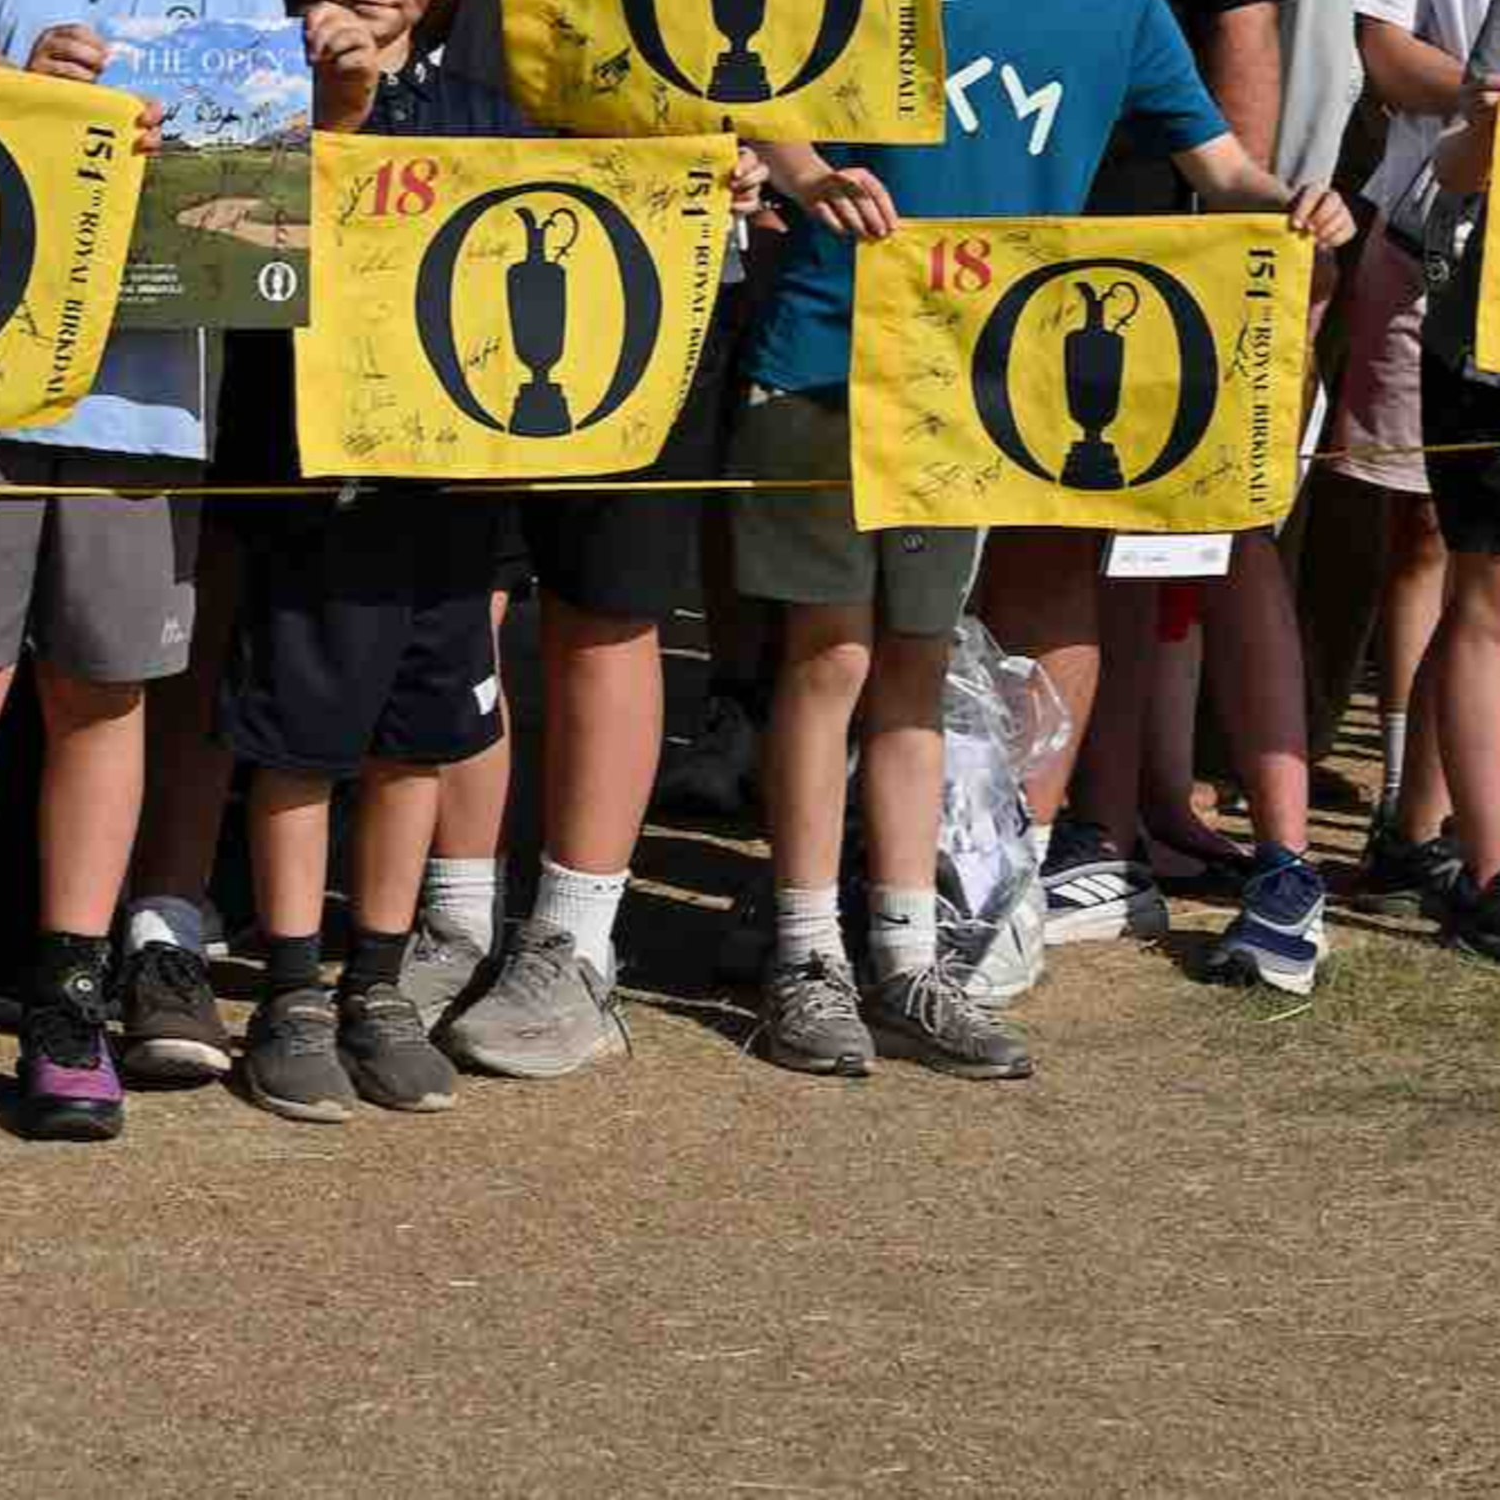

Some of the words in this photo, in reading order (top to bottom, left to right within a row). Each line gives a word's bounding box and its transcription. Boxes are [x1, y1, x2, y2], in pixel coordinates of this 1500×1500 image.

[127, 48, 182, 74] THE
[898, 7, 918, 119] BIRKDALE
[362, 158, 439, 215] 18
[69, 211, 101, 289] ROYAL
[925, 236, 992, 293] 18
[1252, 326, 1273, 392] ROYAL
